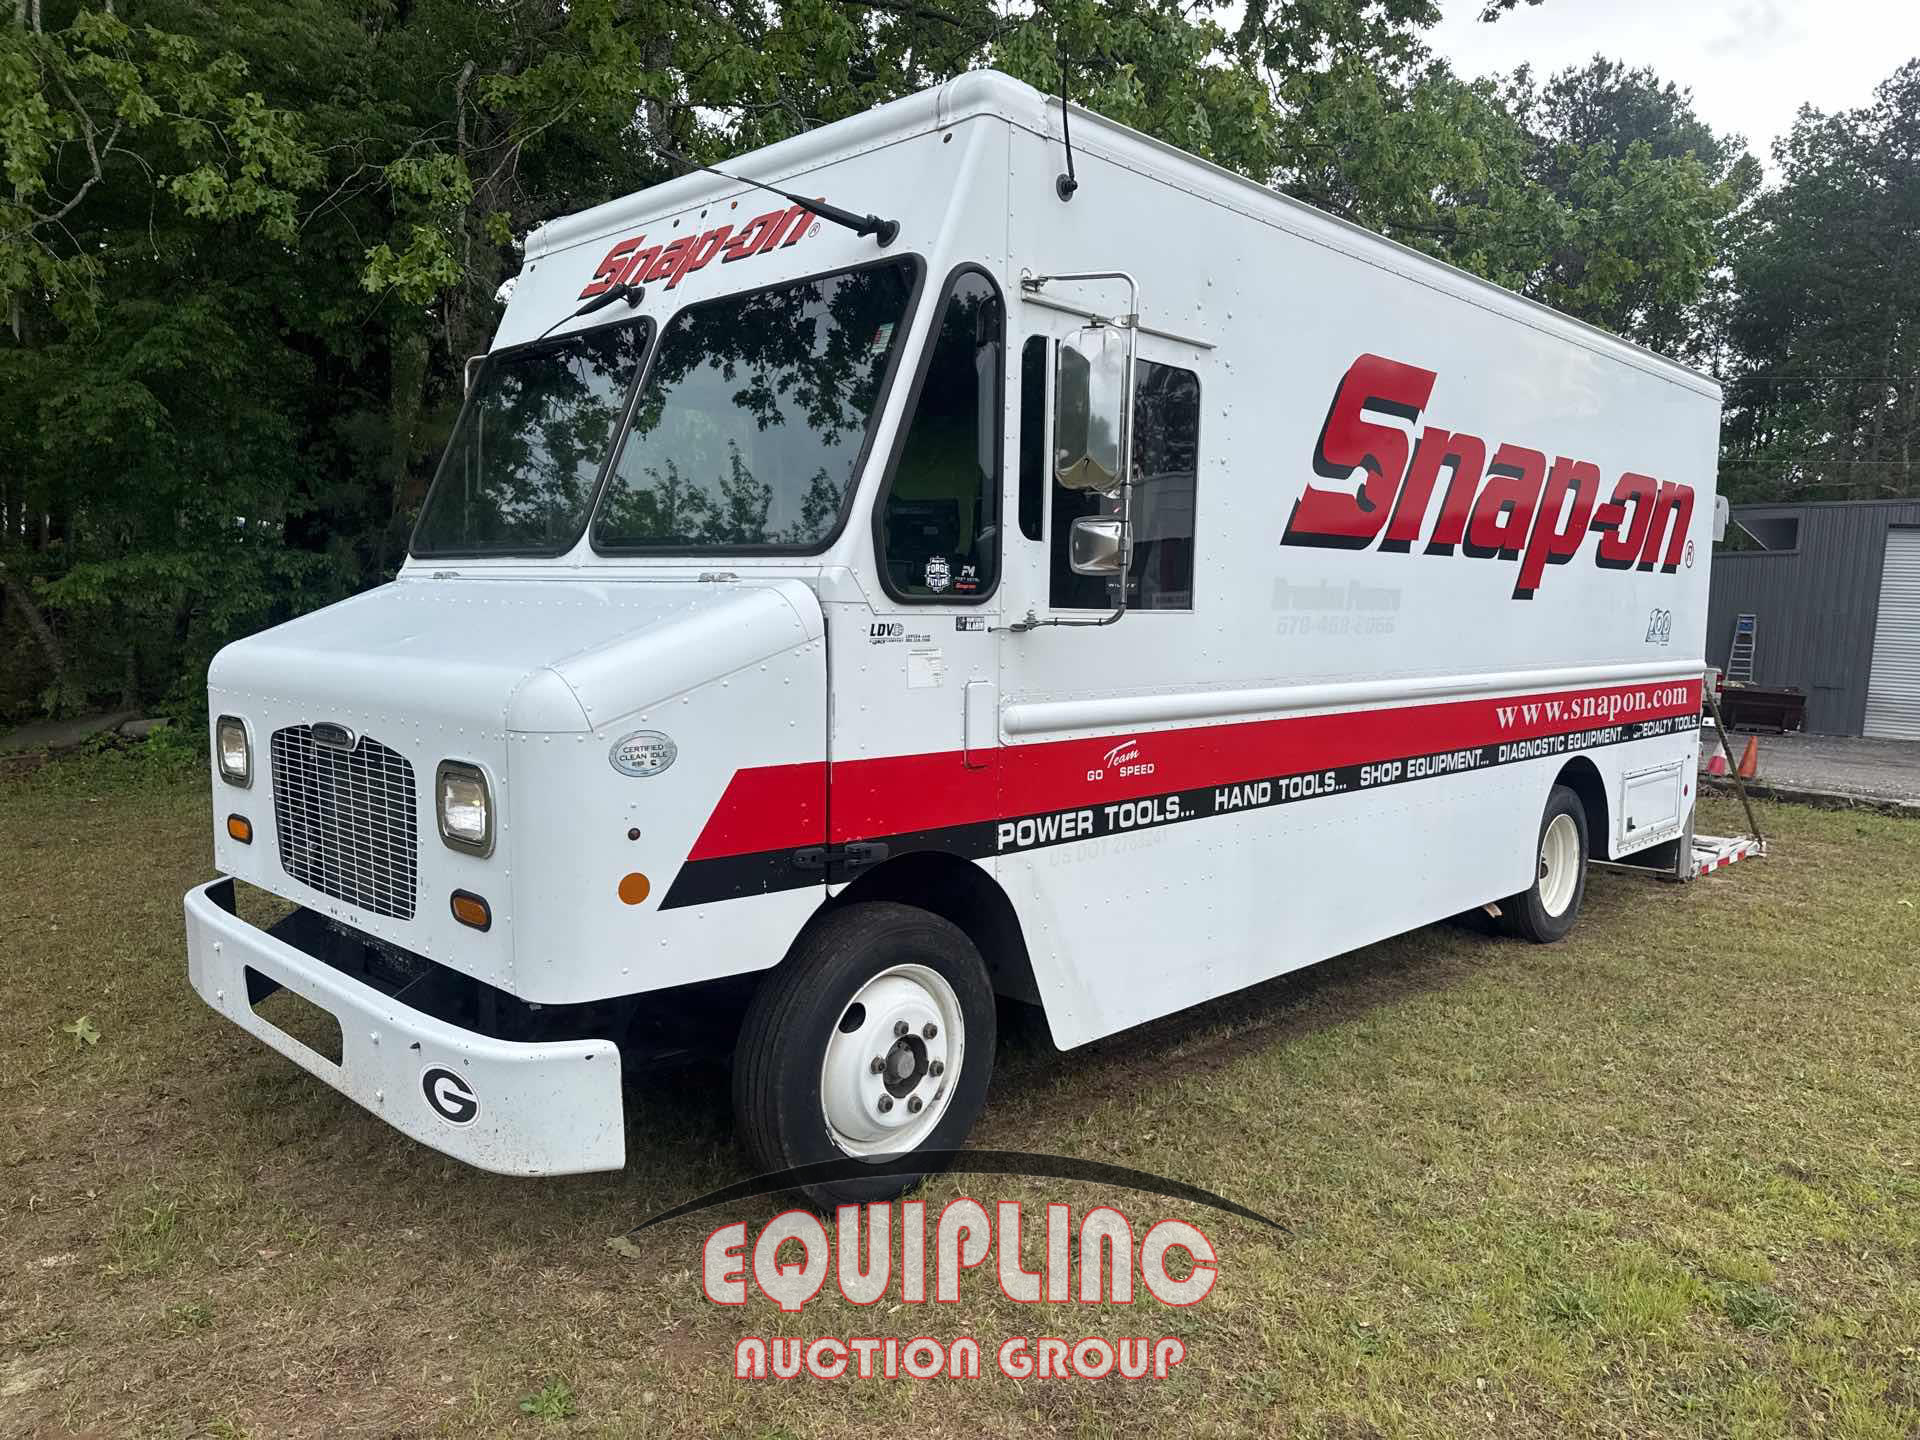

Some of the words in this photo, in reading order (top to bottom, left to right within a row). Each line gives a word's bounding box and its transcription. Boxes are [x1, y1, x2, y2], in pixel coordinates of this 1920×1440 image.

[927, 564, 950, 574] FORGE
[927, 577, 949, 587] FUTURE
[869, 623, 894, 637] LDV
[1495, 684, 1688, 729] www.snapon.com
[619, 753, 647, 761] CLEAN
[622, 744, 664, 754] CERTIFIED
[1104, 740, 1140, 767] Team
[1087, 769, 1104, 781] GO
[1119, 763, 1155, 778] SPEED
[997, 808, 1094, 851] POWER
[1215, 777, 1271, 811] HAND
[1359, 761, 1401, 787] SHOP
[1498, 735, 1565, 763] DIAGNOSTIC
[422, 1067, 479, 1124] G
